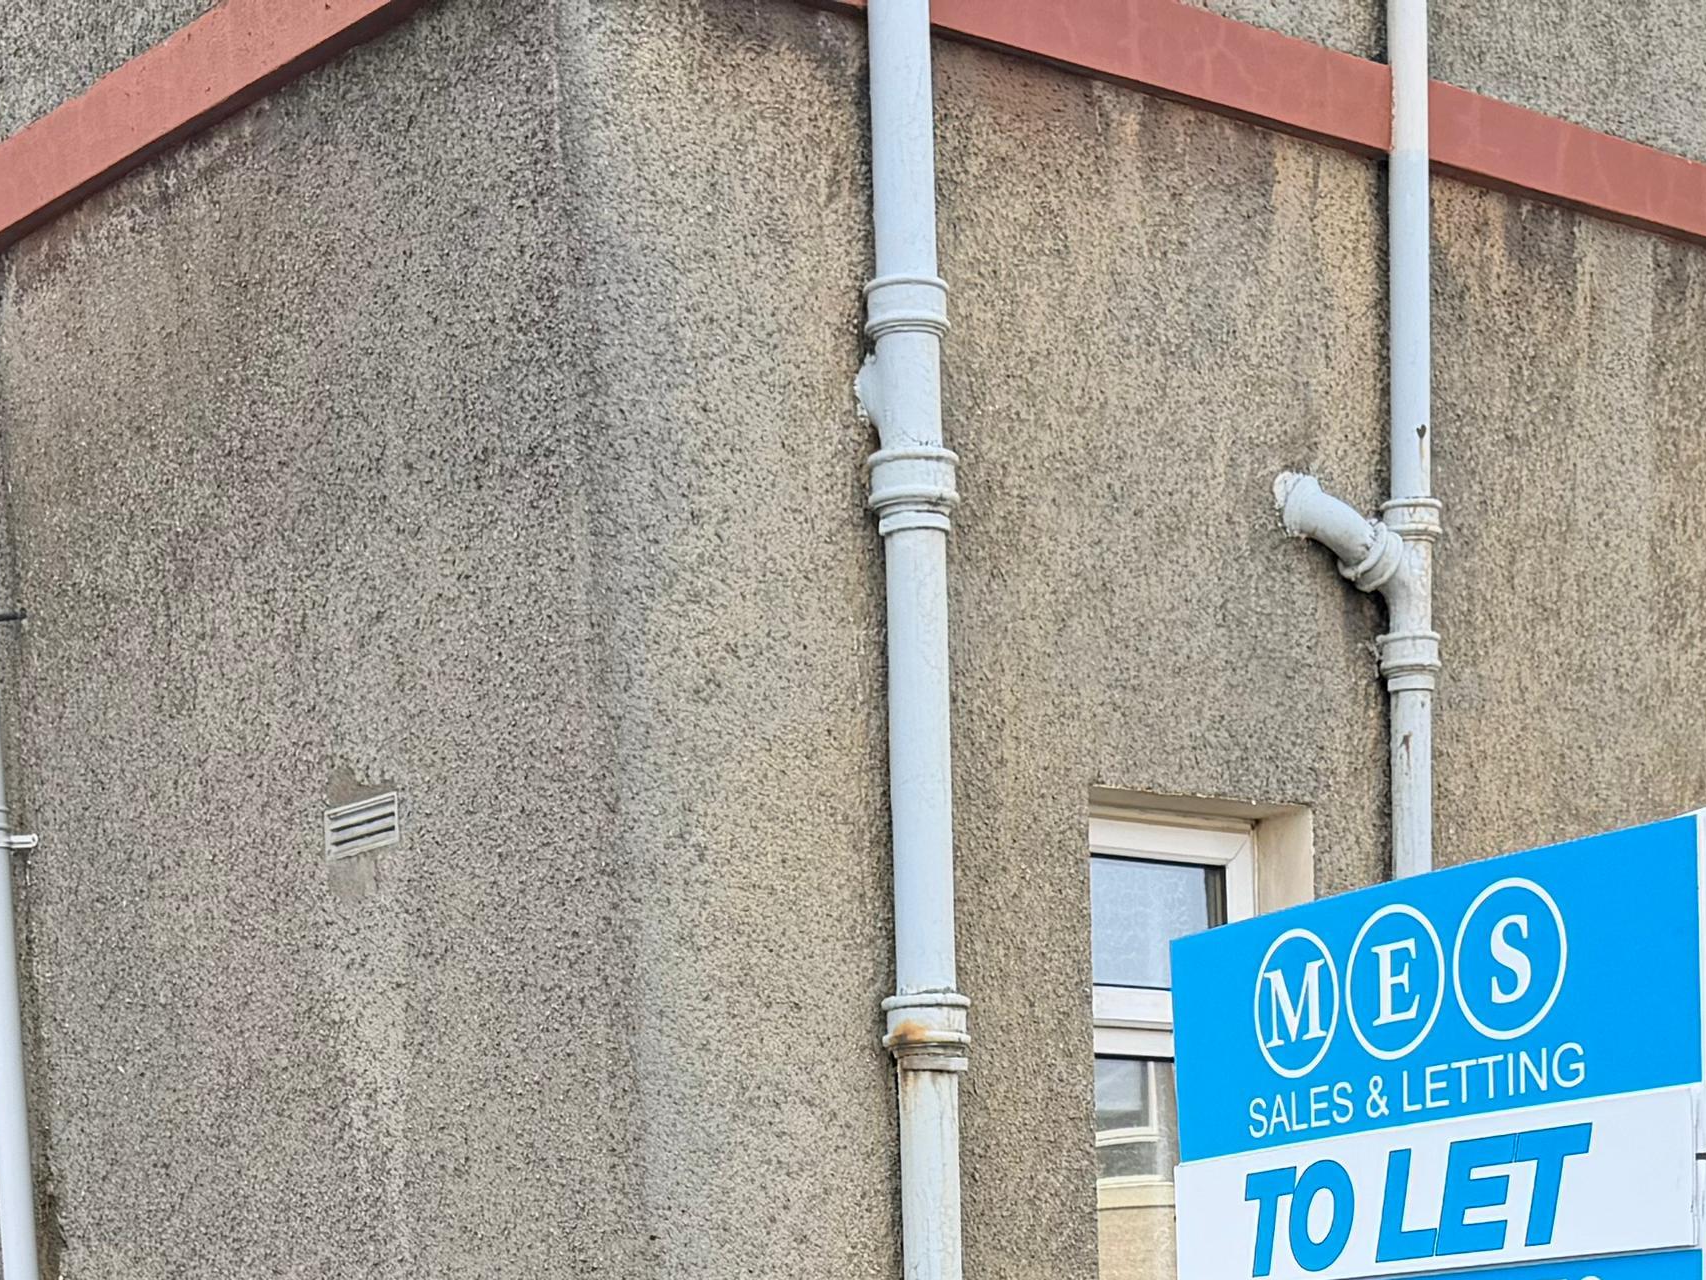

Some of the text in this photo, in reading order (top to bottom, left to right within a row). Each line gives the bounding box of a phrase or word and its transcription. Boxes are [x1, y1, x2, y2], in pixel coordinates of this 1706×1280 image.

[1263, 914, 1532, 1049] MES
[1247, 1042, 1586, 1139] SALES & LETTING
[1244, 1122, 1593, 1279] TO LET
